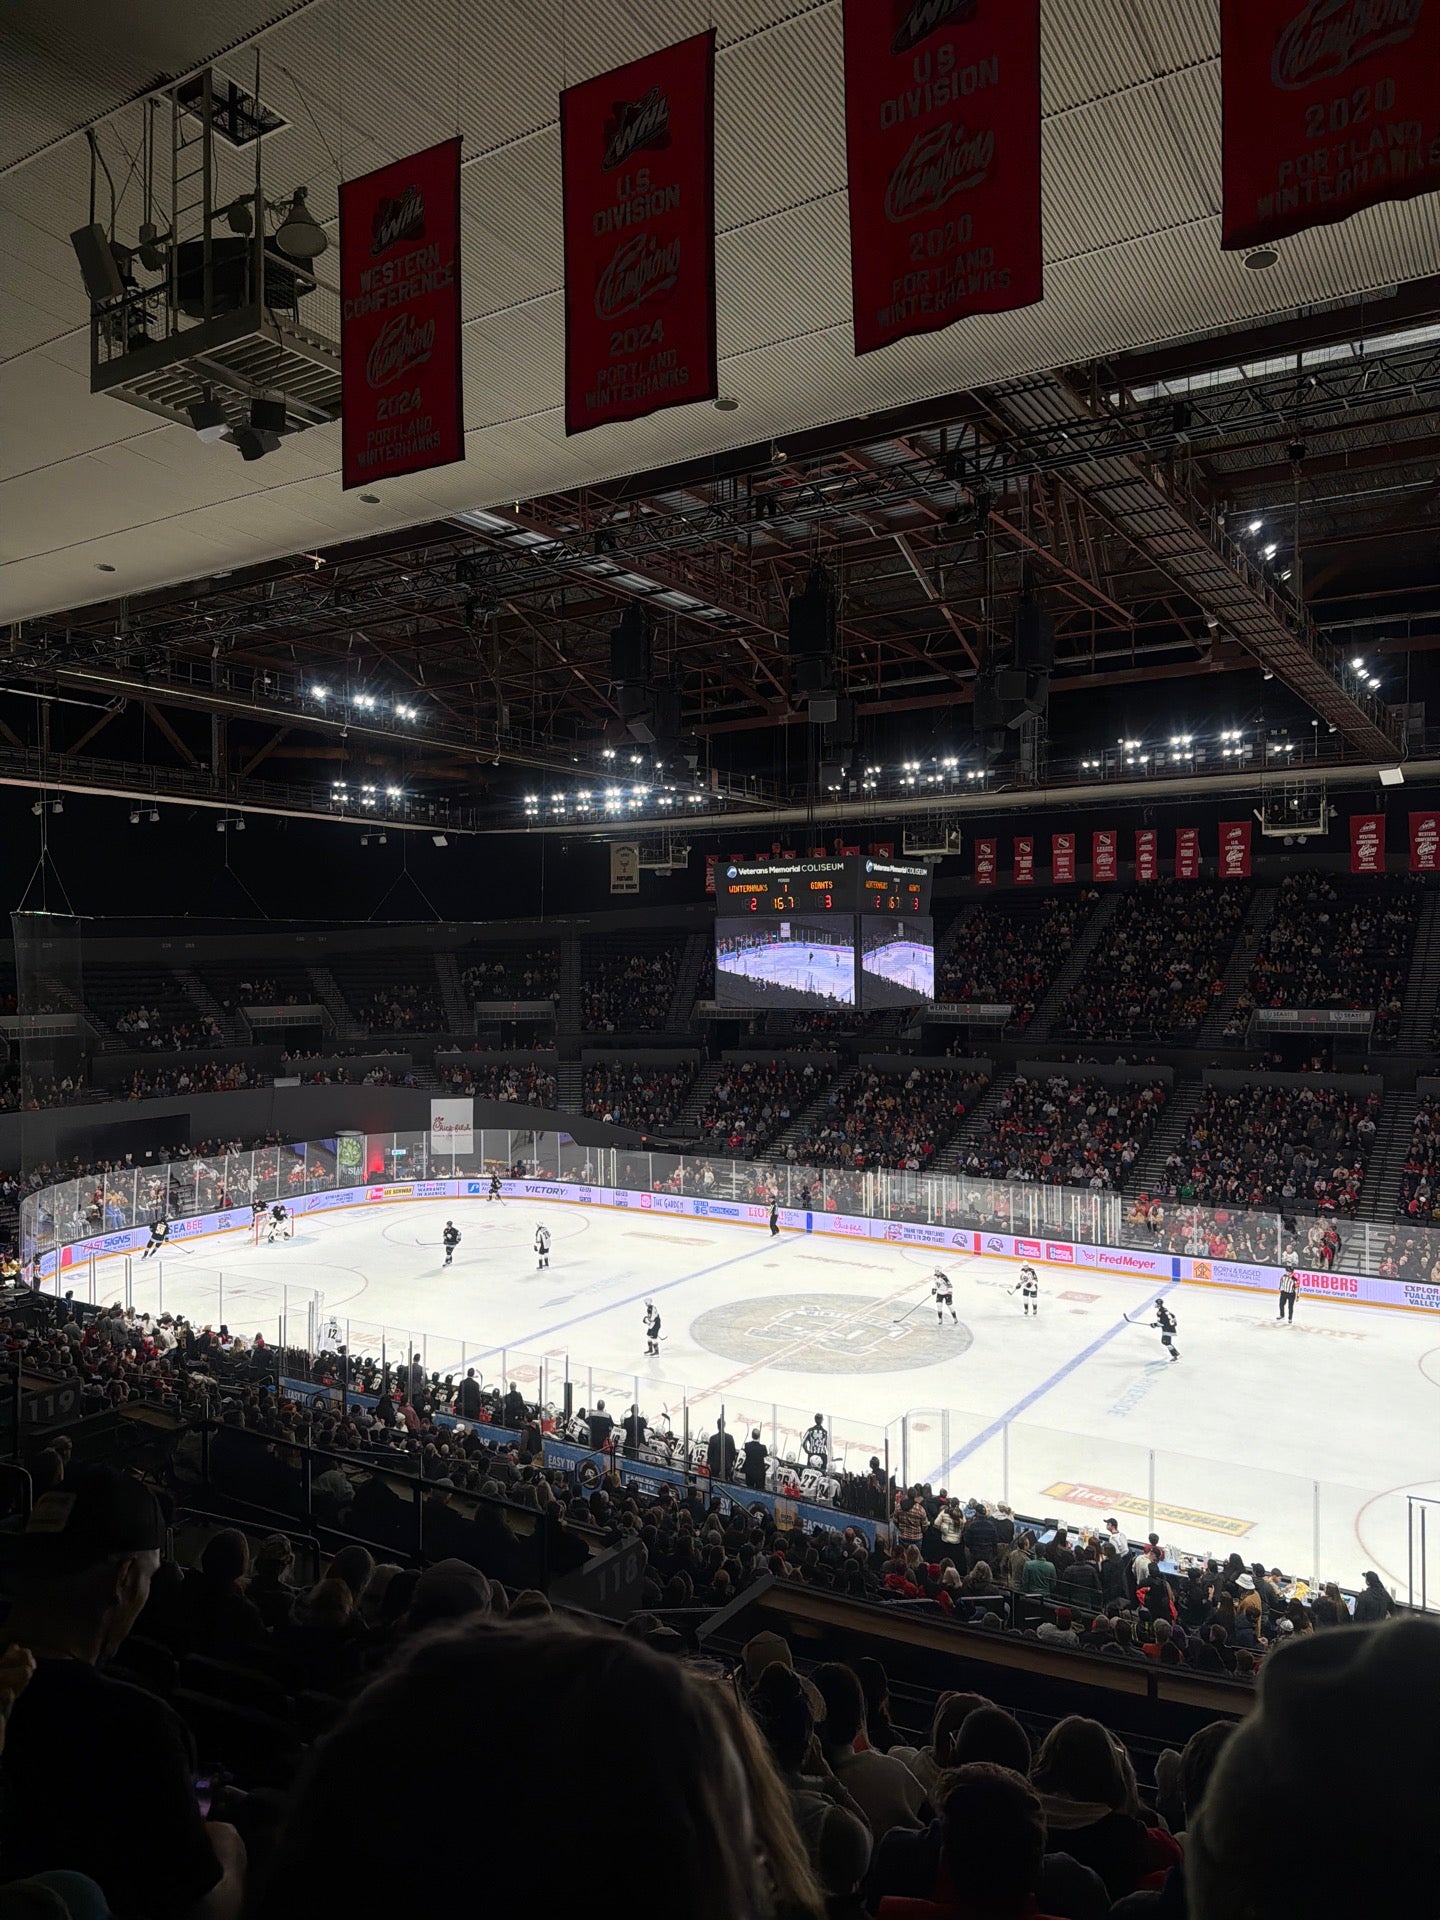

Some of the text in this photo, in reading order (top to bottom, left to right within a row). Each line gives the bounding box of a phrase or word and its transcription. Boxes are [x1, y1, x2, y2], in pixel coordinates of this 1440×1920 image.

[881, 55, 999, 130] DIVISION
[1305, 77, 1395, 137] 2020
[1279, 121, 1422, 186] PORTLAND
[592, 183, 681, 237] DIVISION
[909, 213, 973, 262] 2020
[360, 243, 440, 291] WESTERN
[892, 246, 995, 298] PORTLAND
[344, 263, 455, 320] CONFERENCE
[877, 267, 1011, 329] WINTERHAWKS
[608, 319, 663, 358] 2024
[597, 349, 677, 384] PORTLAND
[377, 387, 422, 422] 2024
[585, 365, 689, 410] WINTERHAWKS
[357, 430, 441, 467] WINTERHAWKS
[366, 415, 432, 447] PORTLAND
[769, 865, 801, 874] Memorial
[801, 863, 844, 872] COLISEUM
[810, 881, 833, 890] GIANTS
[750, 898, 757, 910] 2
[825, 895, 832, 908] 3
[525, 1185, 567, 1196] VICTORY
[710, 1207, 738, 1215] KOIN.COM
[1214, 1265, 1231, 1273] BORN
[1238, 1268, 1261, 1277] RAISED
[1405, 1285, 1440, 1294] EXPLOR
[1409, 1298, 1440, 1308] VALLEY
[548, 1454, 576, 1470] EASY TO
[802, 1474, 817, 1488] 27
[1068, 1486, 1114, 1505] Tires
